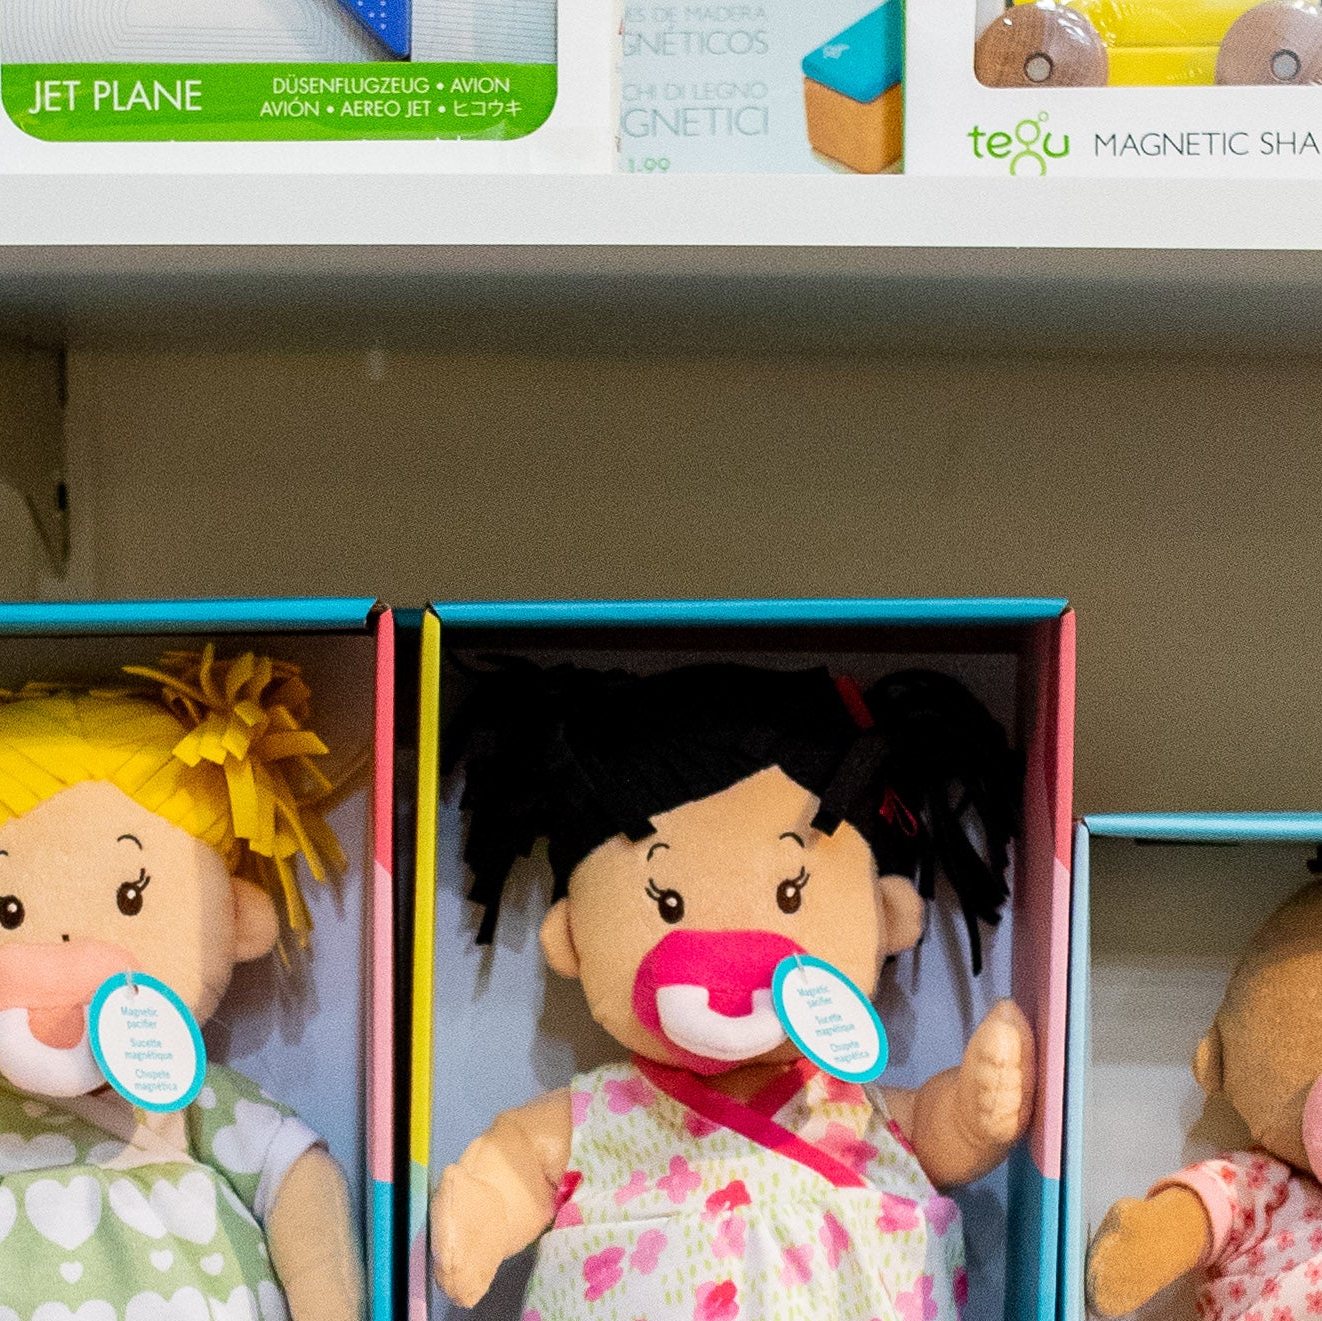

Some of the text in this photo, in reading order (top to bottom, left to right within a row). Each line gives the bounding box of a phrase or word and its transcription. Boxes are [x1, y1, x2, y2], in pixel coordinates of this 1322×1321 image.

[28, 80, 202, 114] JET PLANE
[273, 76, 510, 95] DÜSENFLUGZEUG AVION
[693, 81, 770, 101] LEGNO
[260, 97, 521, 119] AVIÓN AEREO JET ヒコウキ
[968, 111, 1070, 176] tegu
[1095, 131, 1250, 157] MAGNETIC
